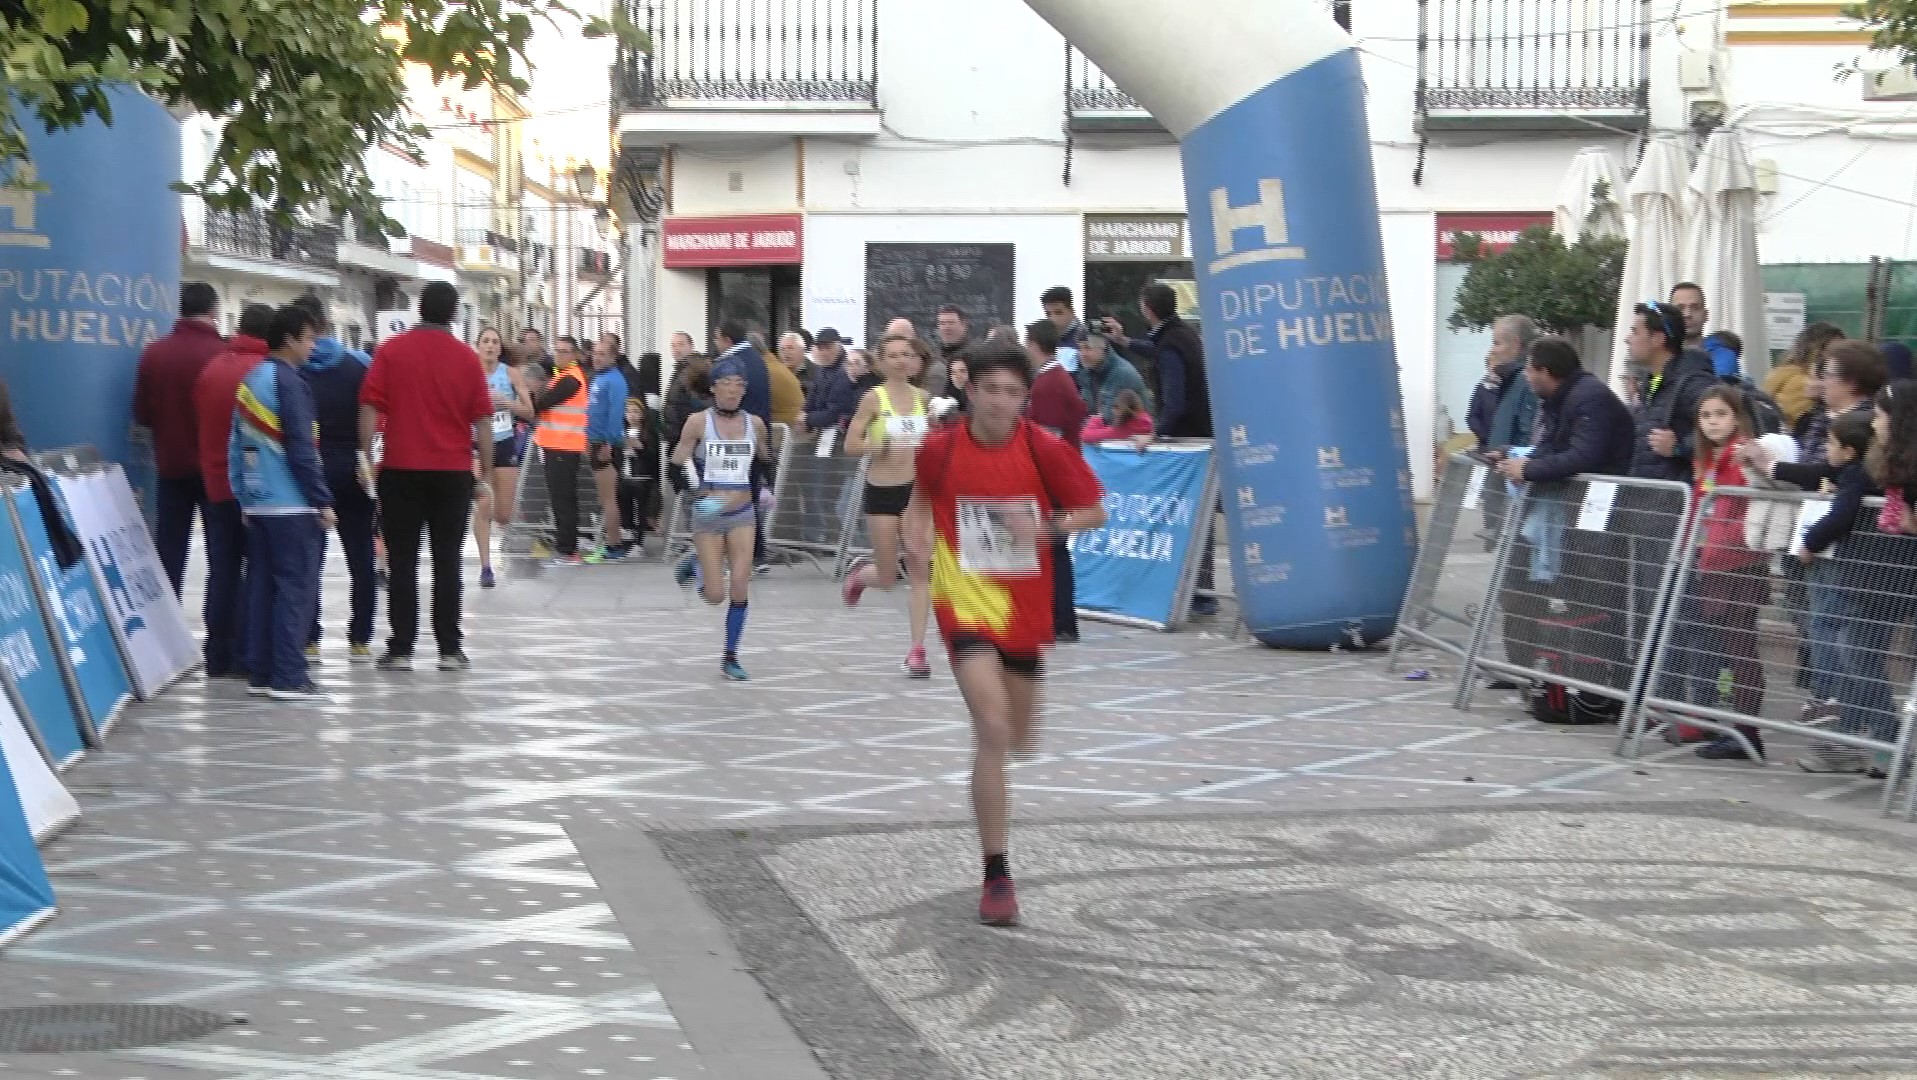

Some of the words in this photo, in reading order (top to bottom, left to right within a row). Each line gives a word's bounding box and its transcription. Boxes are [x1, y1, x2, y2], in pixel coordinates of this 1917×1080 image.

[1089, 222, 1178, 237] MARCHAMO
[667, 233, 732, 250] MARCHAMO
[734, 232, 750, 249] DE
[1089, 241, 1108, 254] DE
[1224, 324, 1267, 360] DE
[1101, 492, 1192, 526] IPUTACIÓN
